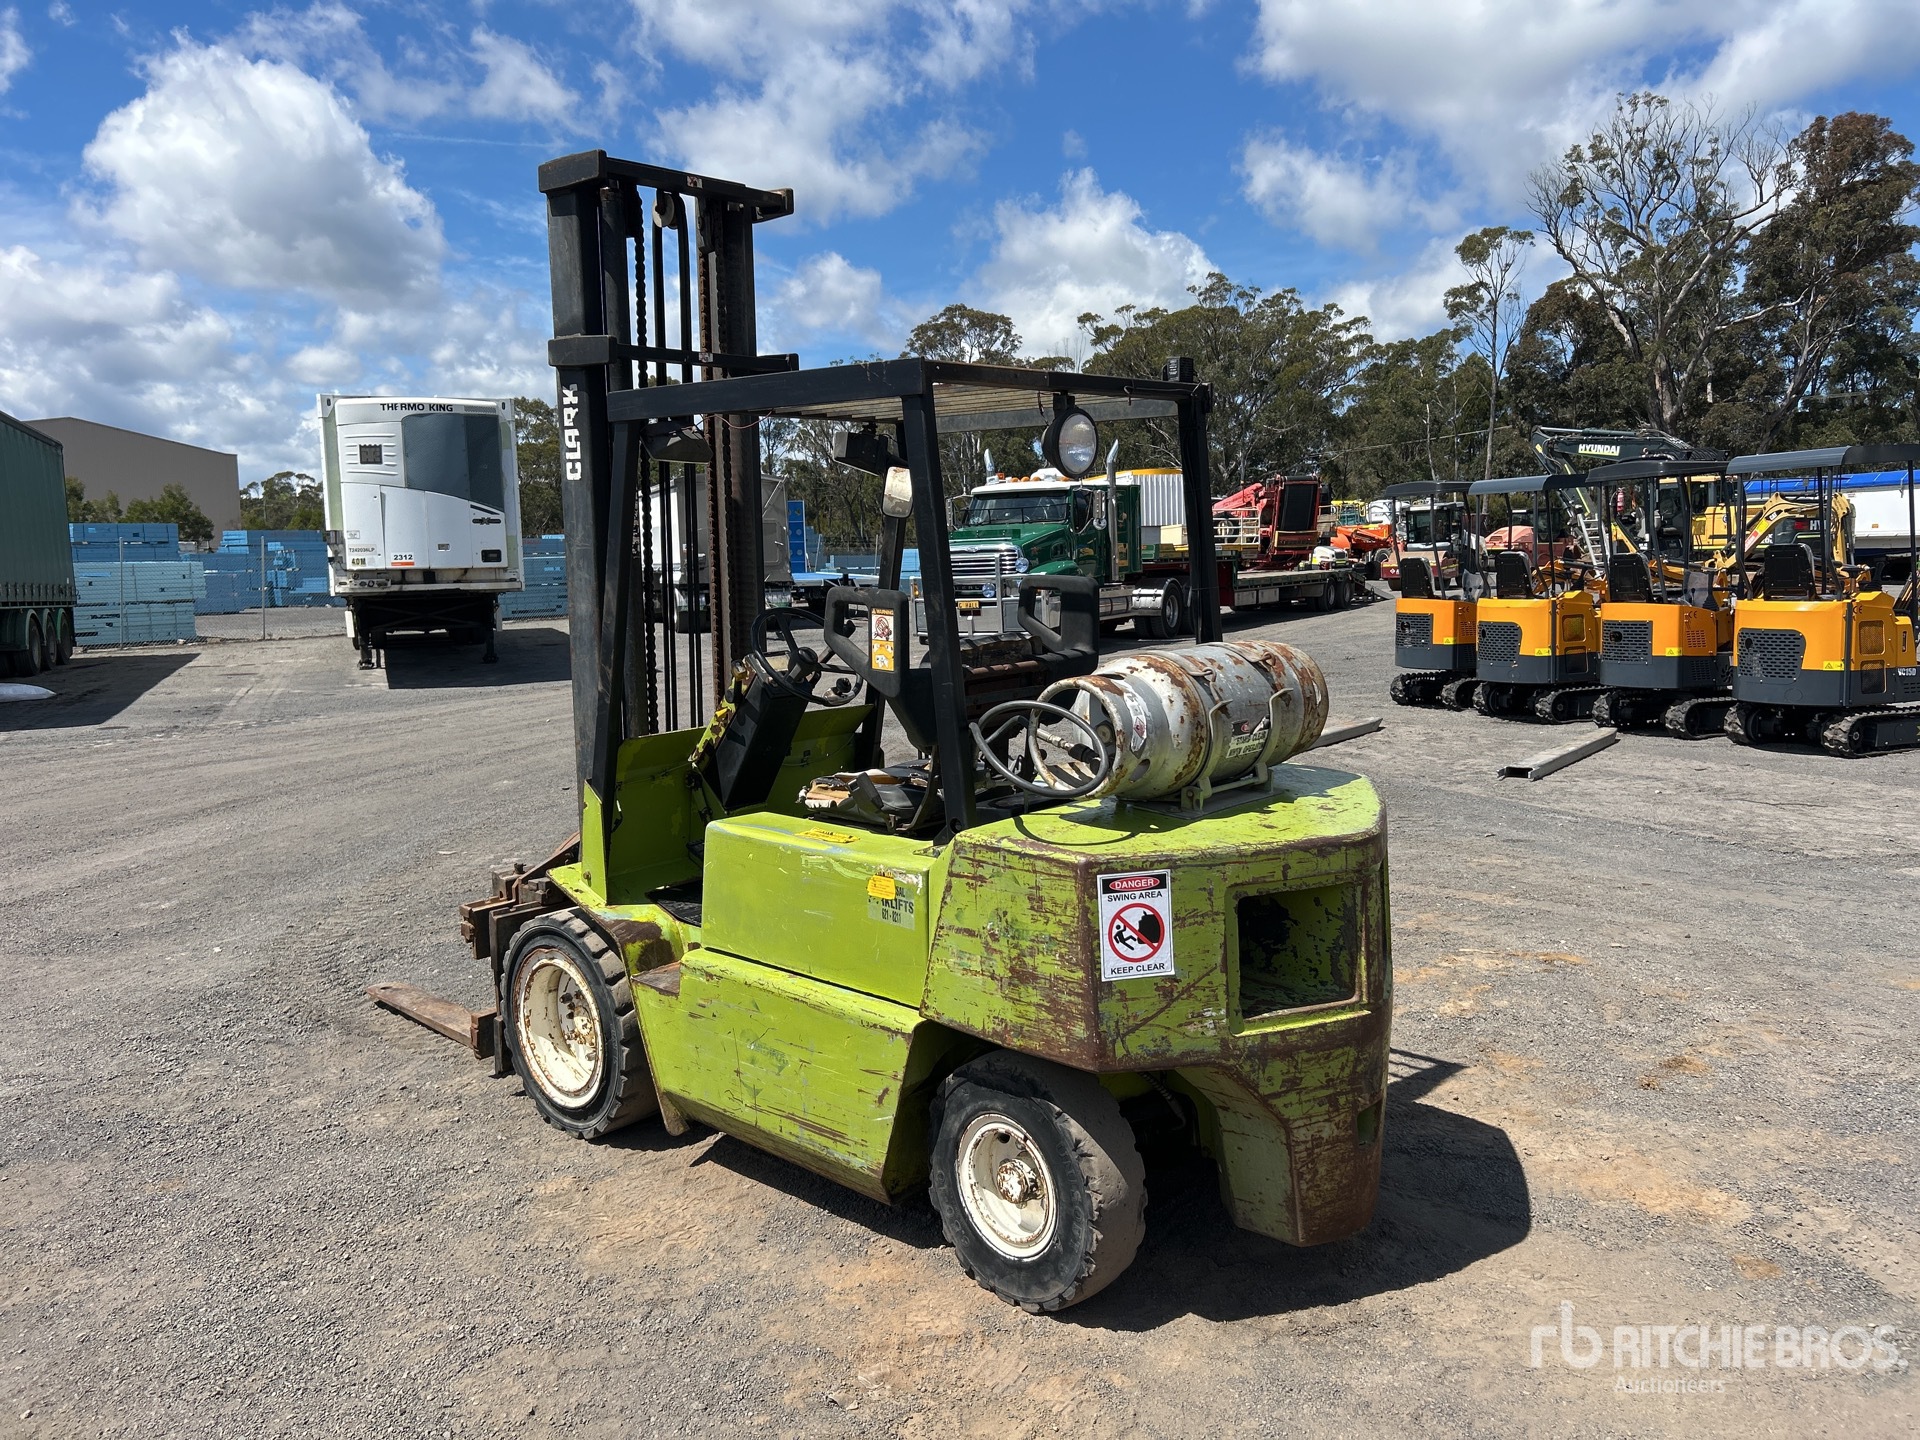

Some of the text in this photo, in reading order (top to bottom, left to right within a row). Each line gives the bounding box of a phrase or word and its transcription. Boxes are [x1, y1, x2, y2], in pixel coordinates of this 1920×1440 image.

[429, 404, 453, 412] KING
[563, 384, 582, 480] CLARK
[1578, 444, 1620, 455] HYUNDAI
[1114, 878, 1154, 889] DANGER
[1107, 890, 1163, 902] SWING AREA
[1110, 962, 1165, 975] KEEP CLEAR
